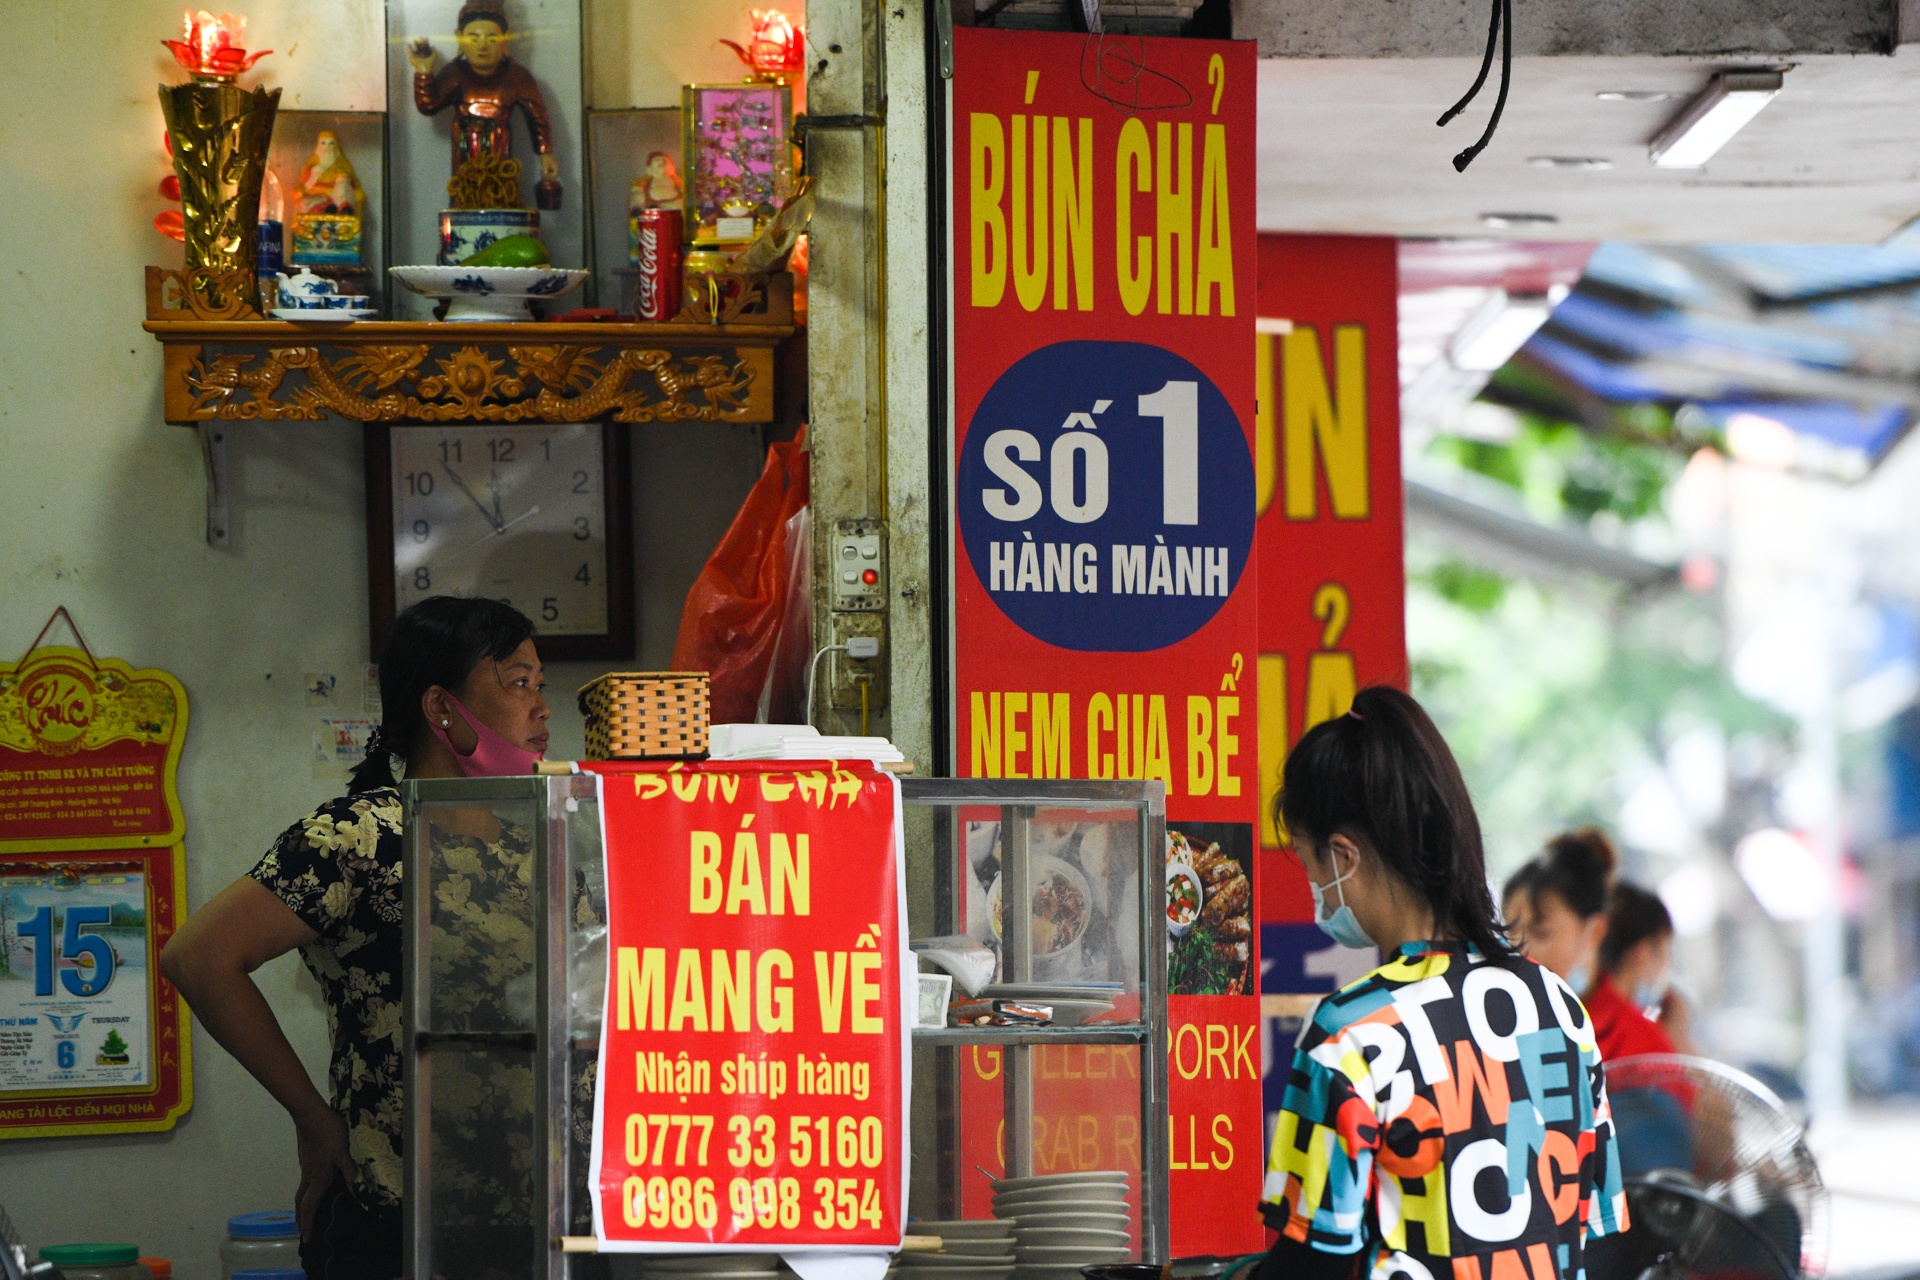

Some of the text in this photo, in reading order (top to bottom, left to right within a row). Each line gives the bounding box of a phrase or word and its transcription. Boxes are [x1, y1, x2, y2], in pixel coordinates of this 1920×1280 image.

[970, 53, 1236, 318] BÚN CHẢ
[439, 439, 463, 463] 11
[487, 438, 515, 462] 12
[540, 439, 551, 461] 1
[982, 380, 1199, 526] SỐ 1
[405, 471, 434, 497] 10
[572, 470, 589, 495] 2
[412, 518, 430, 544] 9
[573, 516, 590, 541] 3
[574, 563, 592, 586] 4
[989, 530, 1230, 597] HÀNG MÀNH
[414, 566, 431, 591] 8
[541, 597, 559, 622] 5
[970, 652, 1242, 797] NEM CUA BỂ
[690, 813, 810, 916] BÁN
[16, 905, 115, 998] 15
[617, 923, 884, 1034] MANG VỀ
[92, 1016, 130, 1024] THURSDAY
[57, 1040, 75, 1069] 6
[1168, 1023, 1258, 1080] ORK
[635, 1050, 711, 1103] Nhận
[797, 1053, 870, 1101] hàng
[0, 1100, 155, 1120] ANG TÀI LỘC ĐẾN MỌI NHÀ
[624, 1112, 883, 1168] 0777 33 5160
[997, 1114, 1099, 1171] RAB
[622, 1175, 883, 1230] 0986 998 354
